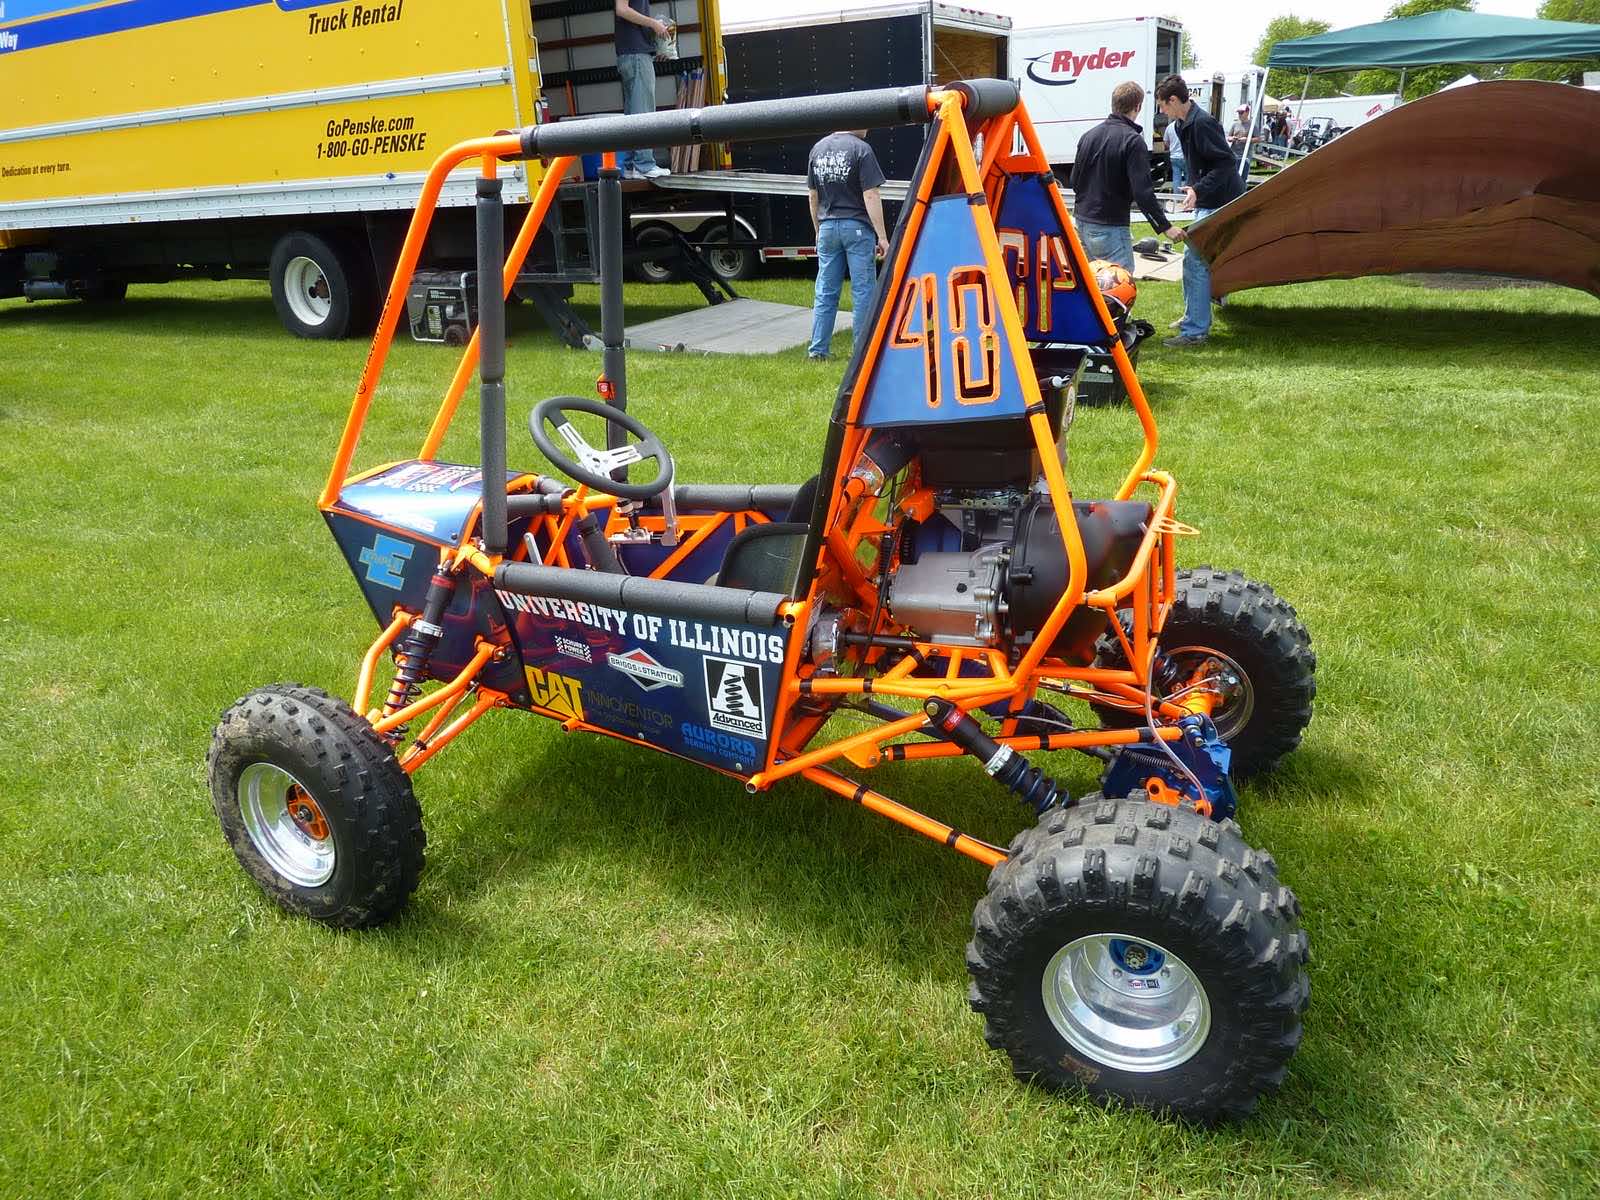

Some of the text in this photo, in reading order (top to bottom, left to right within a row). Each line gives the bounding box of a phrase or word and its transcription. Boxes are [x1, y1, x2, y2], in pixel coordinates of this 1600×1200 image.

[309, 0, 403, 34] Truck Rental
[1051, 47, 1135, 77] Ryder
[327, 116, 414, 137] GoPenske.com
[317, 133, 427, 159] 1-800-GO-PENSKE
[2, 166, 31, 177] Dedication
[32, 165, 39, 174] at
[40, 164, 56, 175] every
[890, 264, 1000, 408] 48
[495, 589, 784, 664] UNIVERSITY OF ILLINOIS
[610, 657, 638, 671] BRIGGS
[642, 667, 679, 682] STRATTON
[525, 665, 584, 720] CAT
[712, 712, 763, 731] Advanced
[681, 721, 757, 758] AURORA
